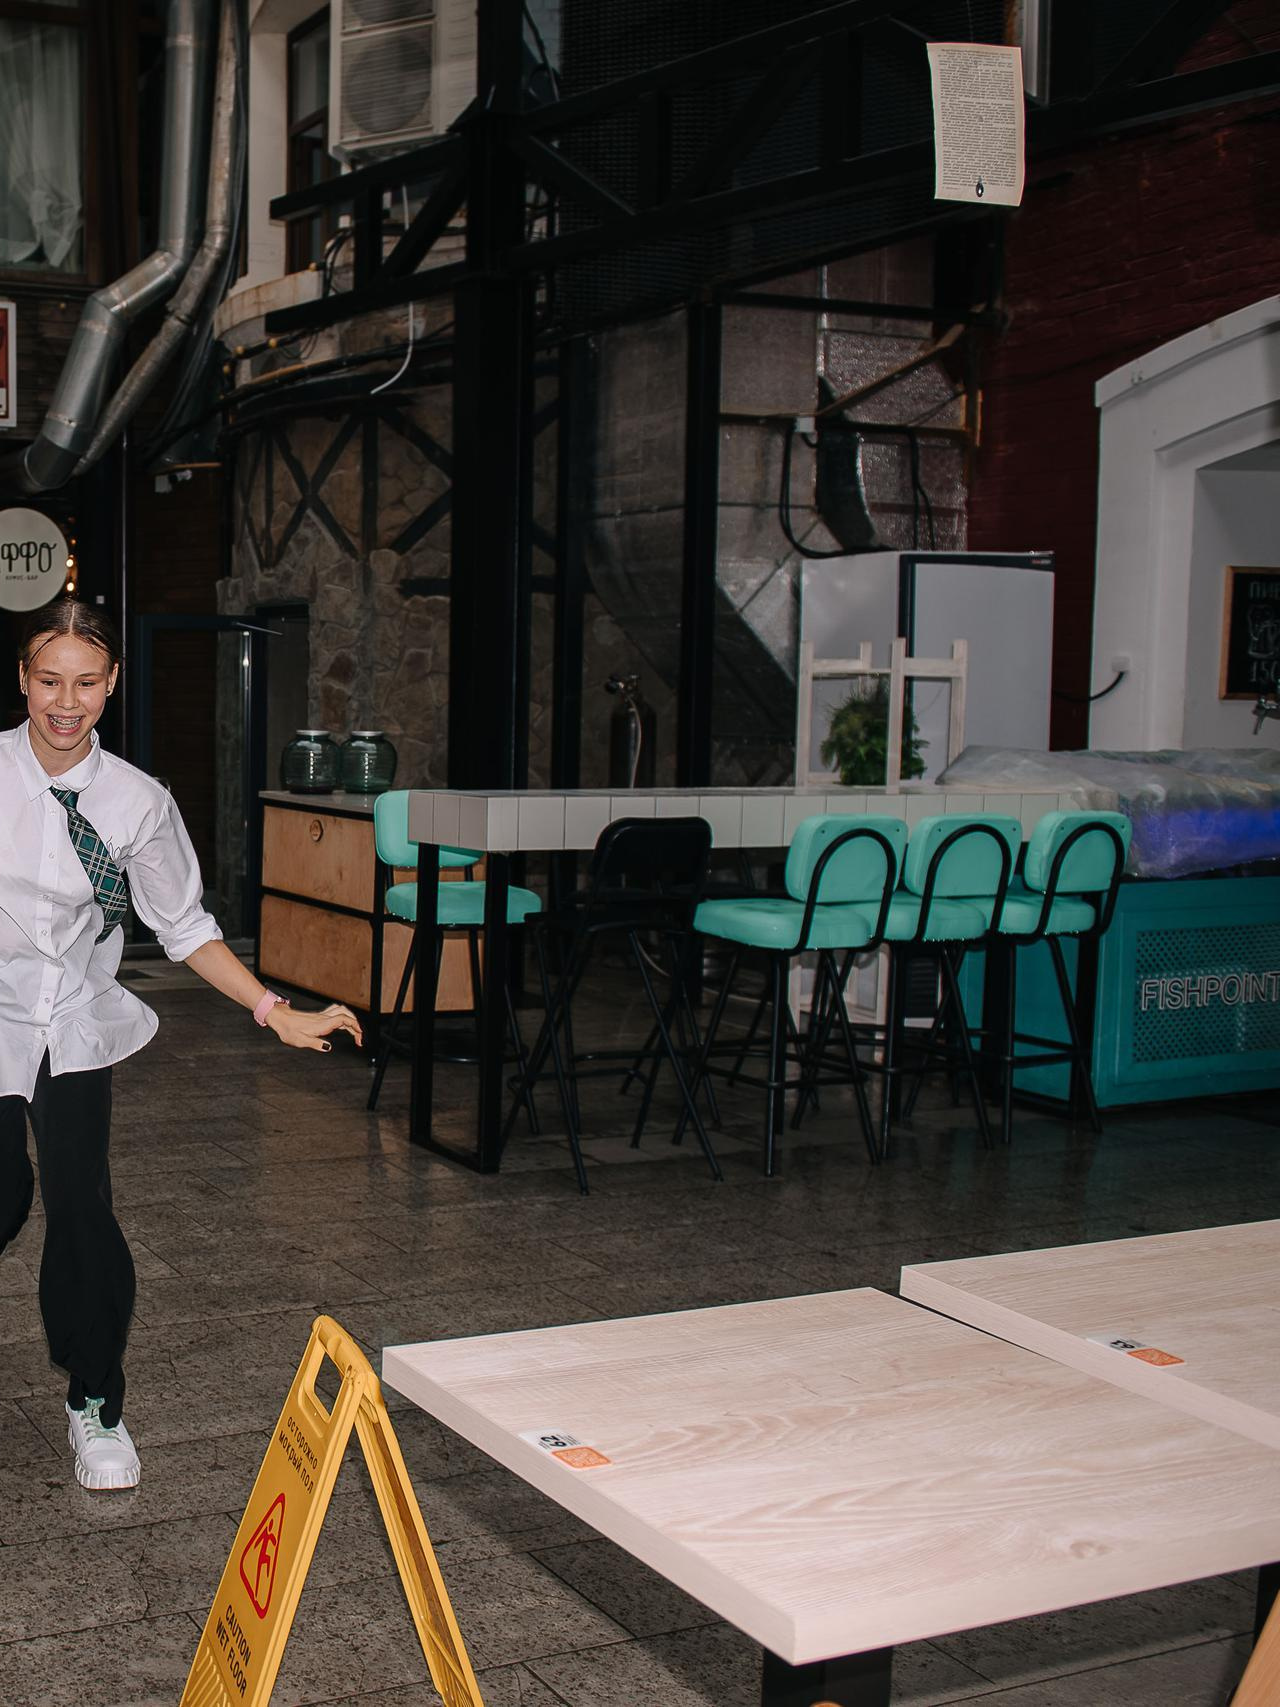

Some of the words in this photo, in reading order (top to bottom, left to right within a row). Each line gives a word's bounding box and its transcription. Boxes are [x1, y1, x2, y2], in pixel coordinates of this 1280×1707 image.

[278, 1430, 303, 1474] мокрый
[300, 1467, 314, 1494] пол
[287, 1416, 318, 1470] осторожно
[216, 1616, 230, 1650] WET
[226, 1645, 247, 1698] FLOOR
[225, 1604, 251, 1667] CAUTION
